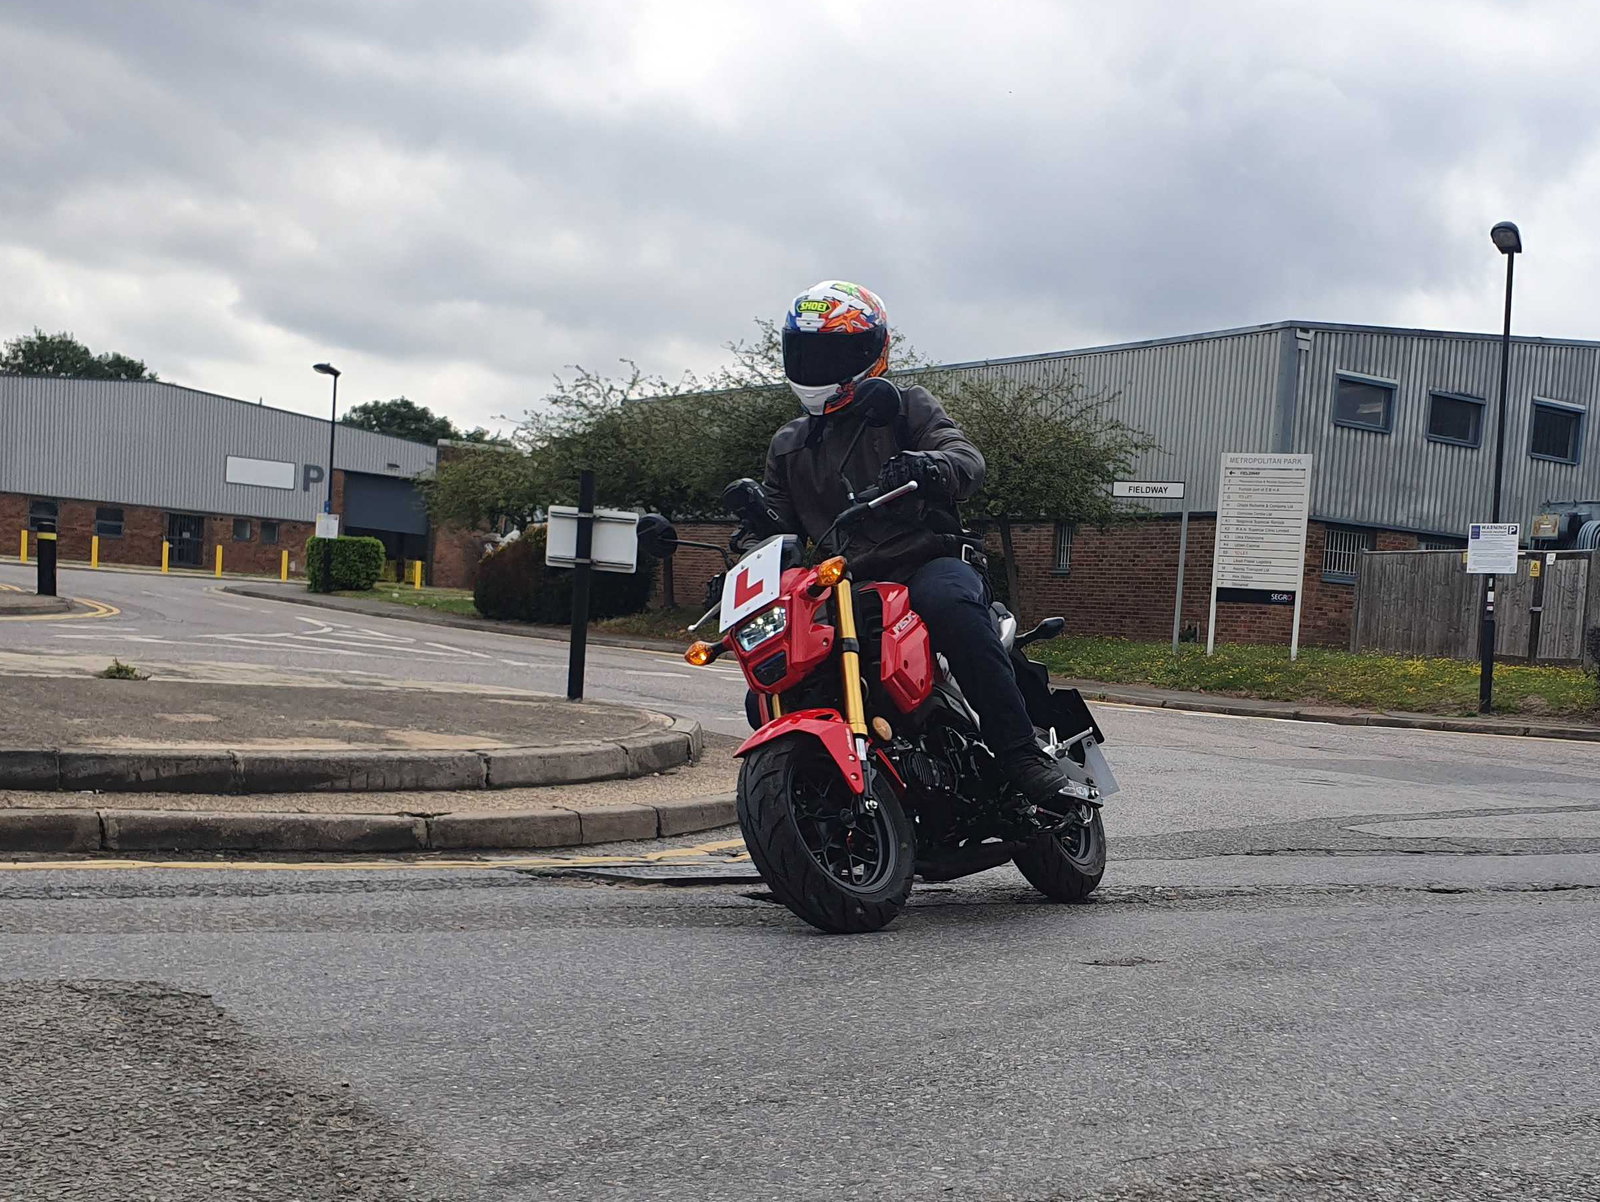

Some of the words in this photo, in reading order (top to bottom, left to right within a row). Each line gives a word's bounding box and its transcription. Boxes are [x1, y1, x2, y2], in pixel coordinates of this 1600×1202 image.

[800, 301, 828, 310] SHOEI
[1283, 457, 1303, 465] PARK
[303, 464, 324, 492] P
[1509, 526, 1516, 535] P
[734, 567, 764, 610] L
